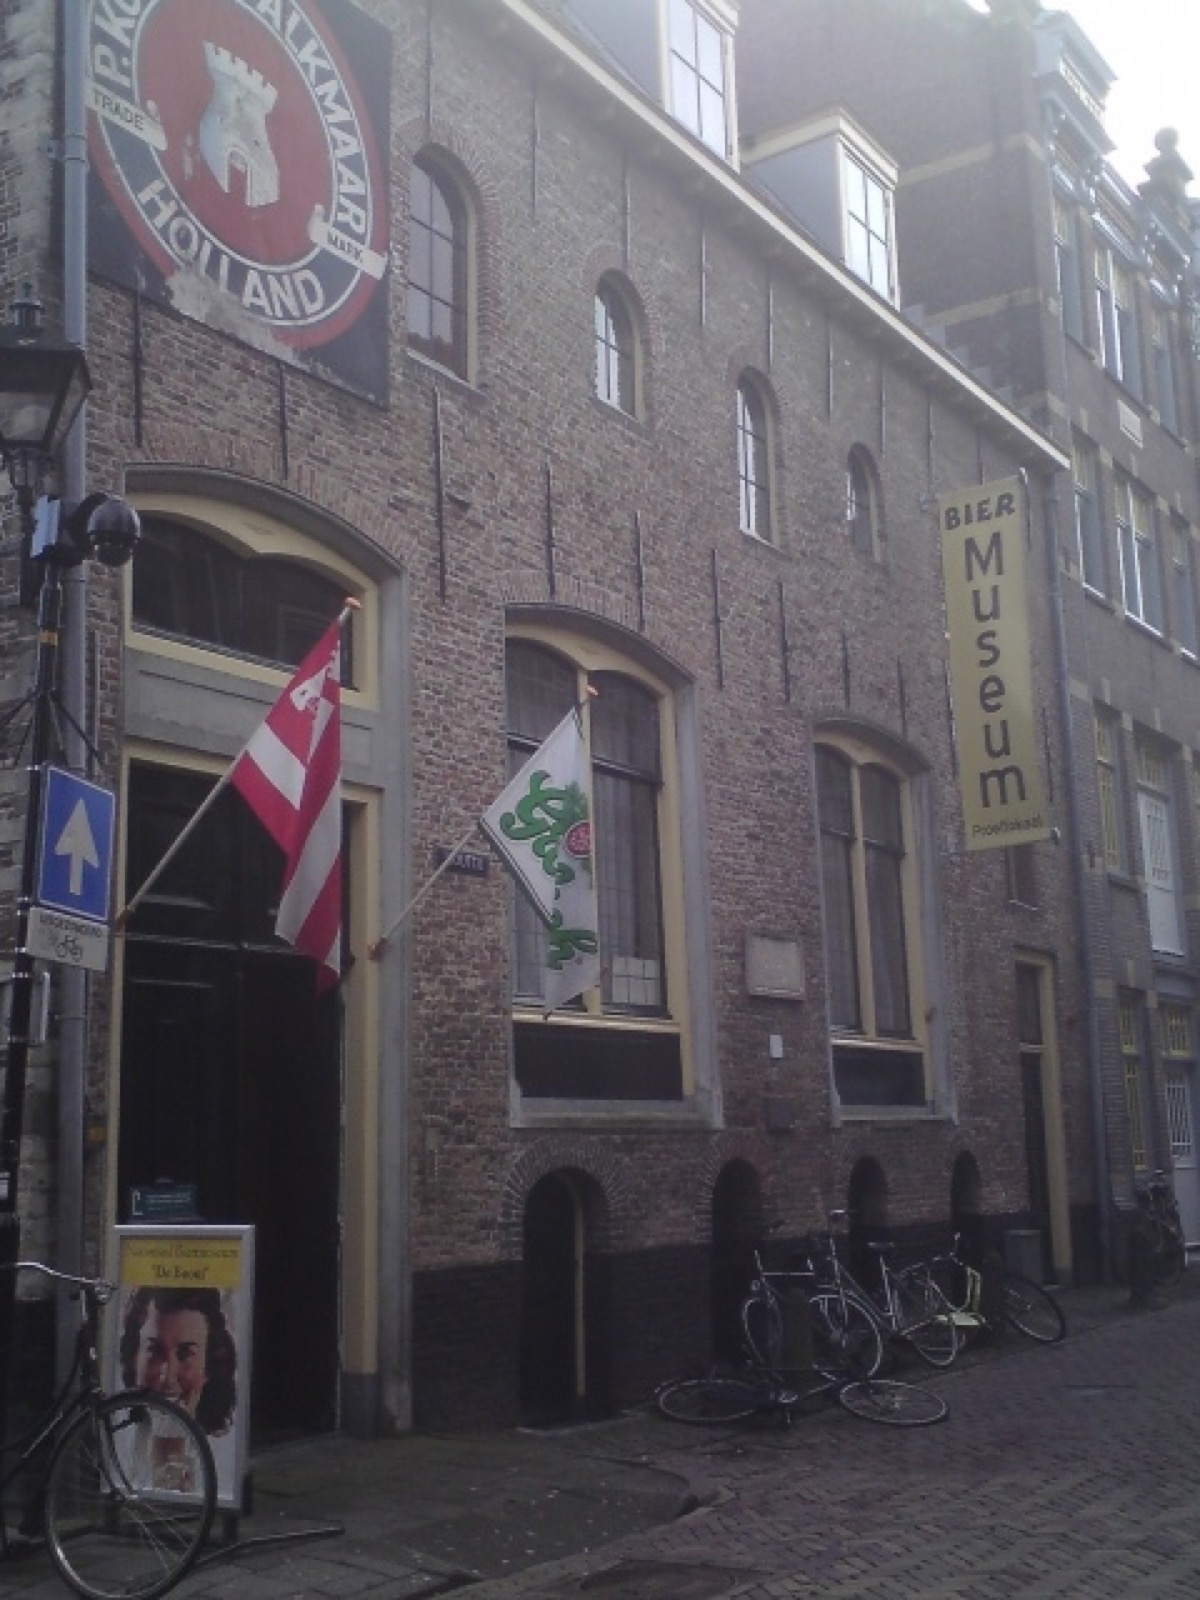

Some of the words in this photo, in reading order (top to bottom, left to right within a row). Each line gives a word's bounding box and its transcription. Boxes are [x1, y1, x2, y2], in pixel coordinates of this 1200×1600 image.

[93, 88, 144, 130] TRADE
[257, 0, 366, 235] ALKMAAR
[138, 179, 324, 319] HOLLAND
[944, 492, 1017, 531] BIER
[964, 531, 1027, 808] Museum
